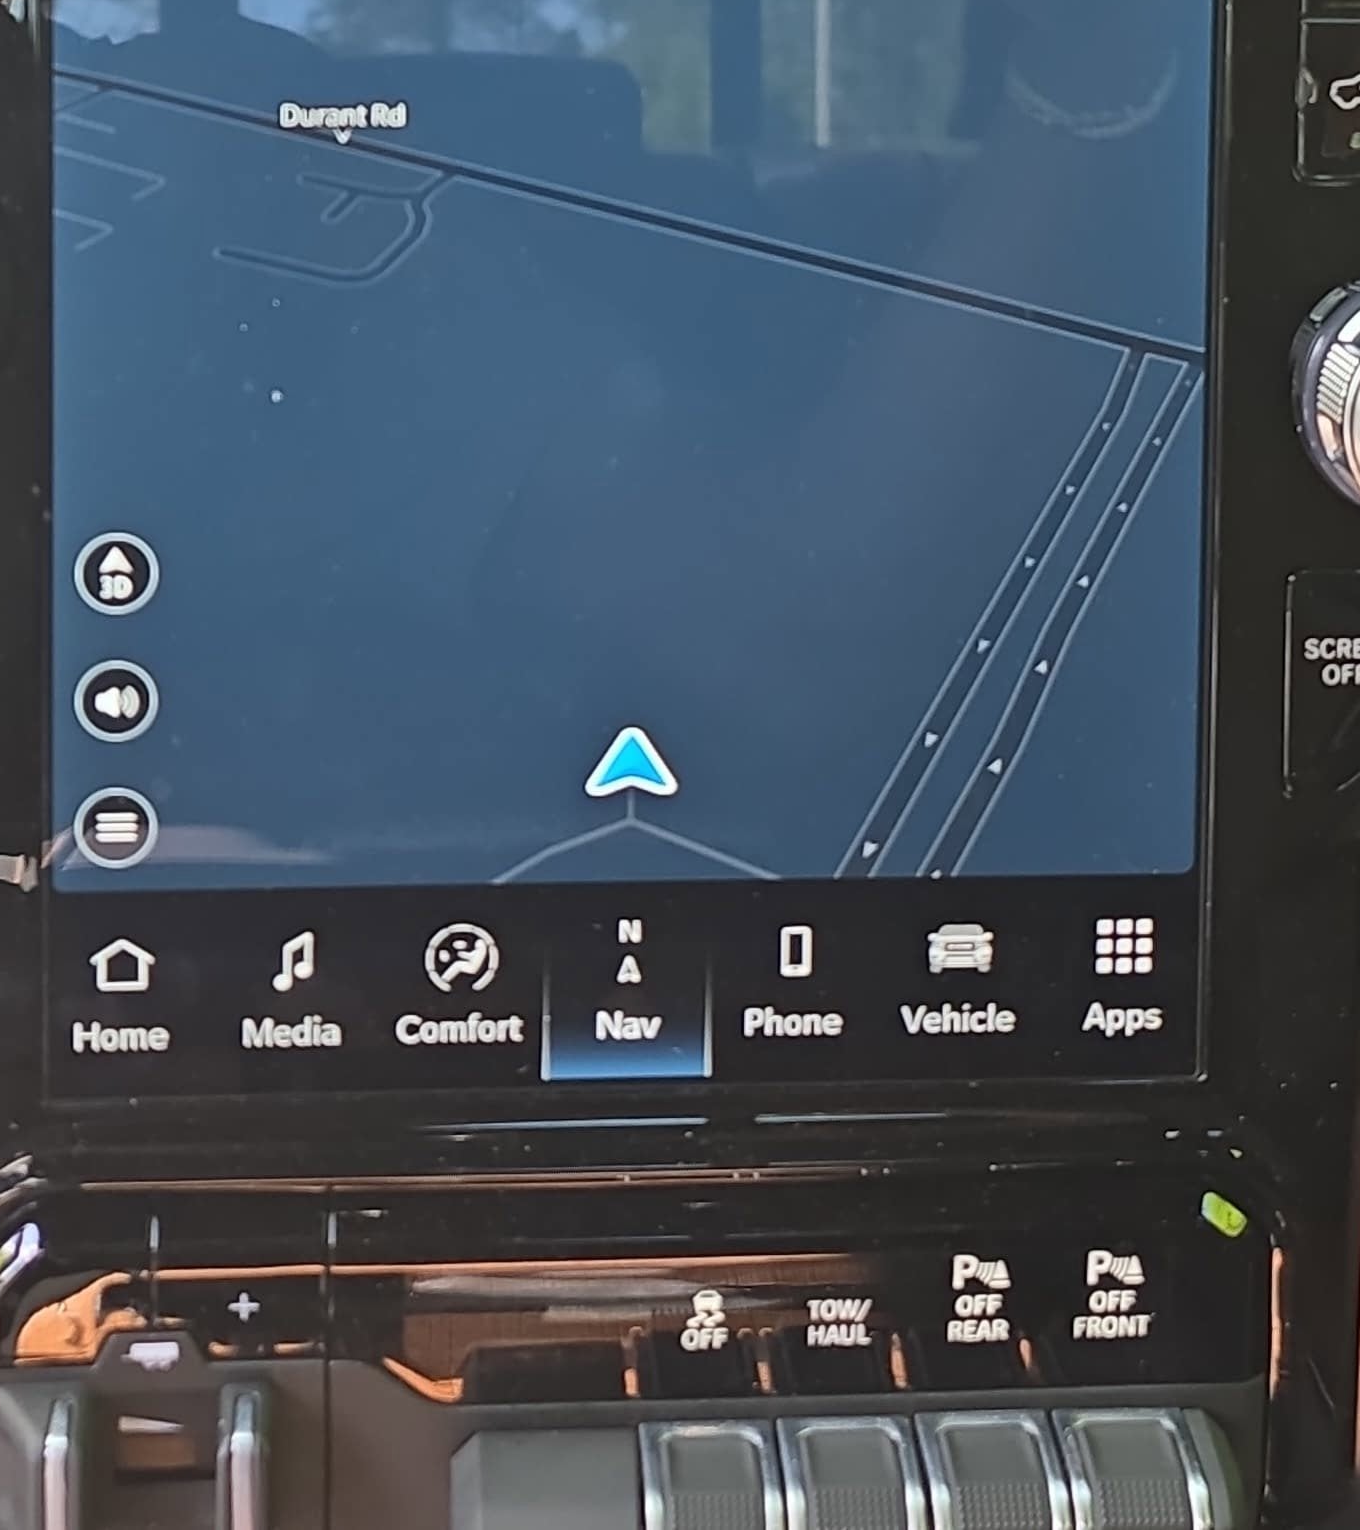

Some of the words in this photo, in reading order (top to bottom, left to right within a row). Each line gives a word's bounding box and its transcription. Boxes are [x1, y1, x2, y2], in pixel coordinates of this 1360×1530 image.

[279, 102, 367, 129] Durant
[370, 102, 407, 129] Rd
[99, 574, 134, 600] 3D
[241, 1015, 341, 1049] Media
[395, 1012, 524, 1046] Comfort
[595, 1010, 662, 1041] Nav
[743, 1006, 844, 1038] Phone
[900, 1002, 1017, 1035] Vehicle
[1082, 1001, 1163, 1038] Apps
[72, 1021, 170, 1054] Home
[807, 1298, 873, 1322] TOW/
[955, 1294, 1004, 1318] OFF
[1089, 1290, 1137, 1314] OFF
[680, 1327, 728, 1352] OFF
[806, 1323, 871, 1348] HAUL
[946, 1319, 1010, 1343] REAR
[1072, 1313, 1151, 1340] FRONT
